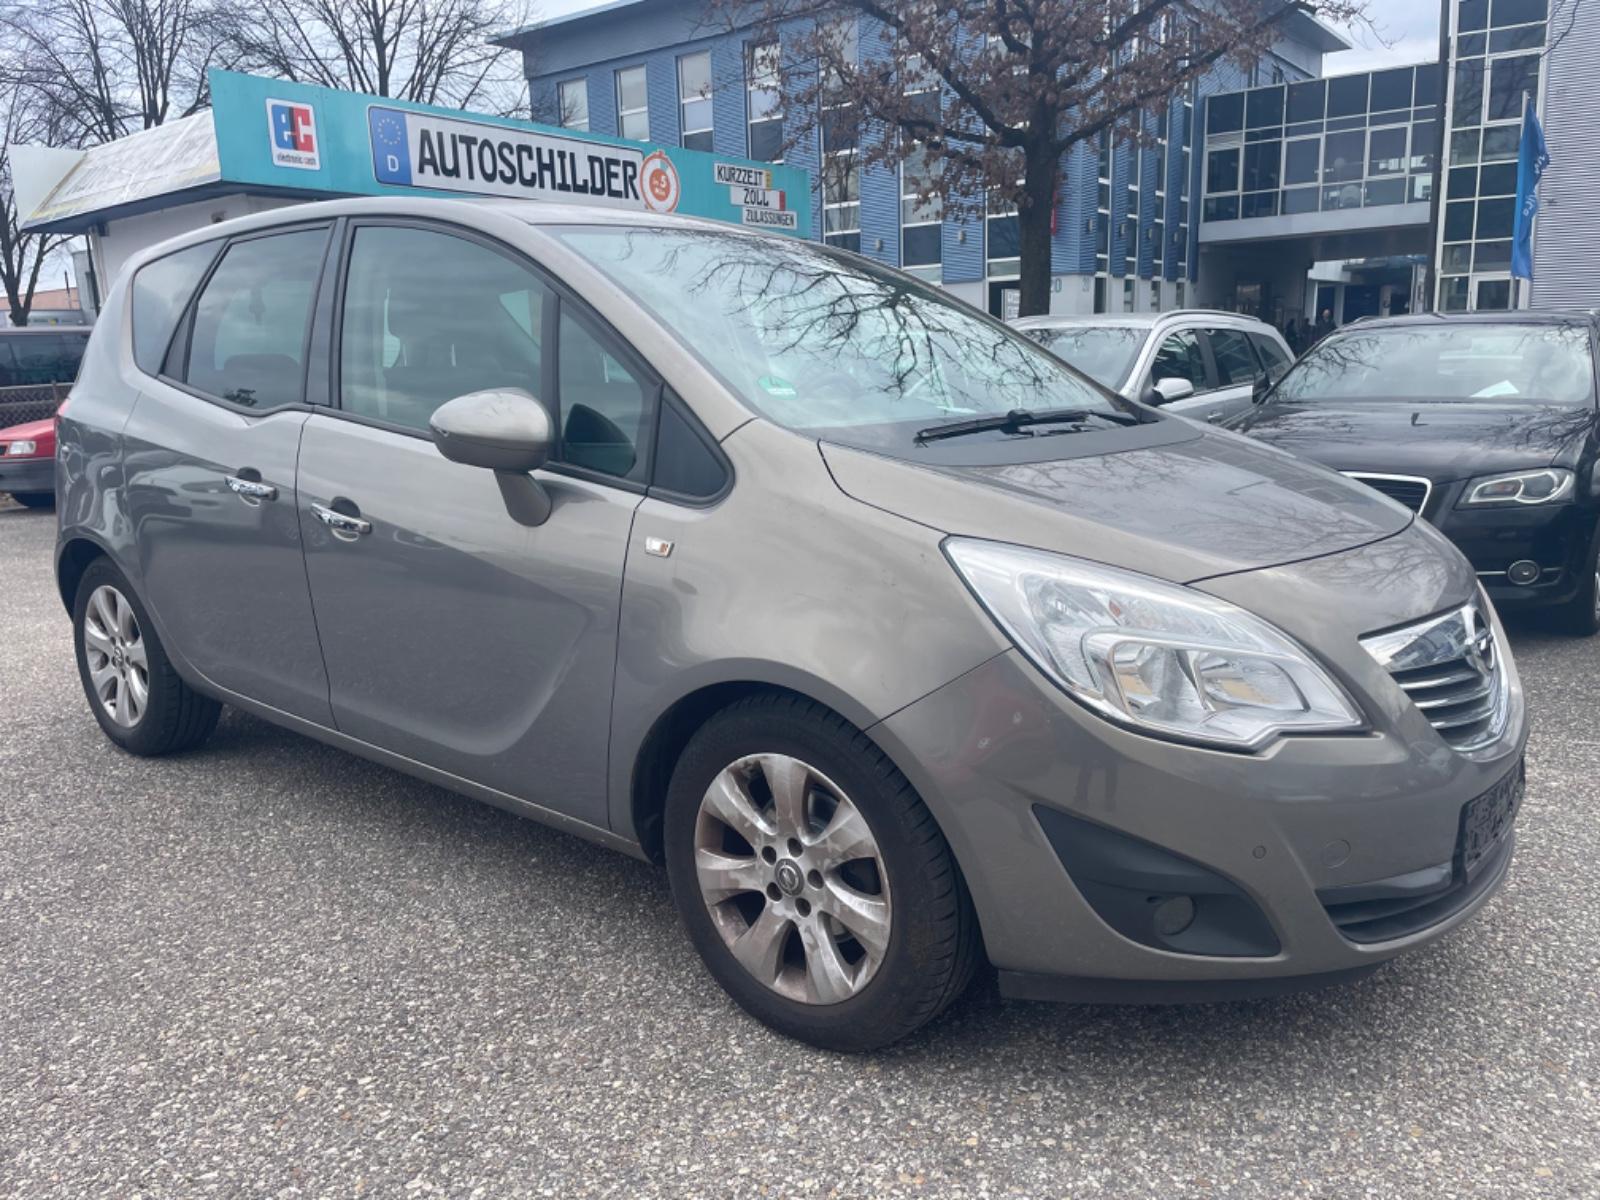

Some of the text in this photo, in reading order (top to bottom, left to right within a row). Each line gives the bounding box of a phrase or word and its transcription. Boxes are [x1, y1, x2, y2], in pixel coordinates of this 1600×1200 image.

[387, 155, 398, 172] D
[418, 129, 639, 200] AUTOSCHILDER
[716, 165, 763, 186] KURZZEIT
[743, 188, 769, 207] ZOLL
[745, 209, 794, 226] ZULASSUNGEN
